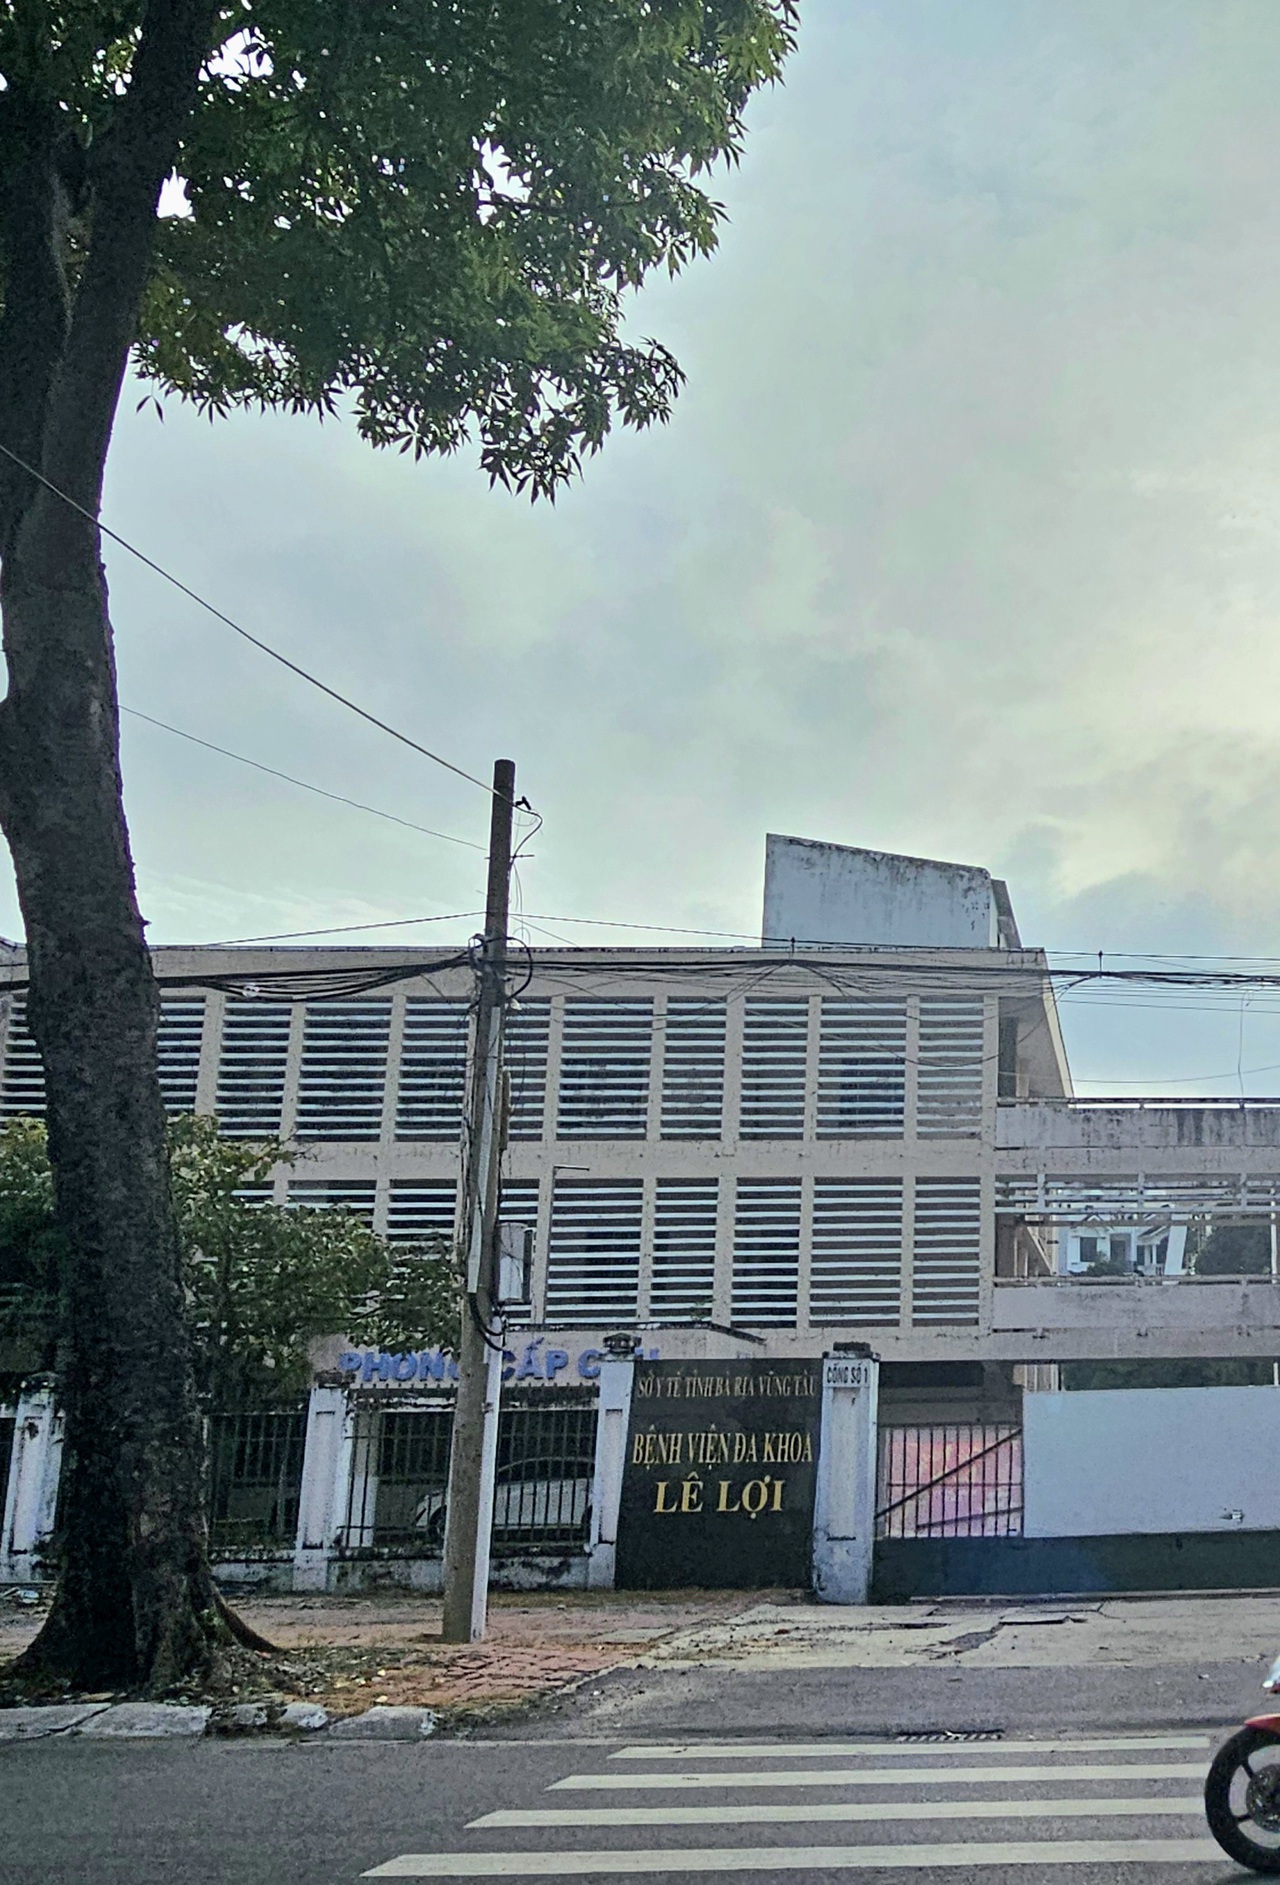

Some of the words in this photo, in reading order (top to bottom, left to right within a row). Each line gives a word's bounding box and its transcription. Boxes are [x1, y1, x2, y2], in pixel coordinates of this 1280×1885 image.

[655, 1376, 664, 1398] Y
[685, 1369, 713, 1398] TỈNH
[715, 1370, 731, 1397] BÀ
[759, 1370, 791, 1397] VŨNG
[863, 1366, 868, 1383] 1
[632, 1424, 683, 1470] BỆNH
[688, 1423, 730, 1470] VIỆN
[733, 1432, 757, 1463] ĐA
[762, 1432, 812, 1463] KHOA
[653, 1471, 704, 1513] LÊ
[716, 1475, 785, 1519] LỢI
